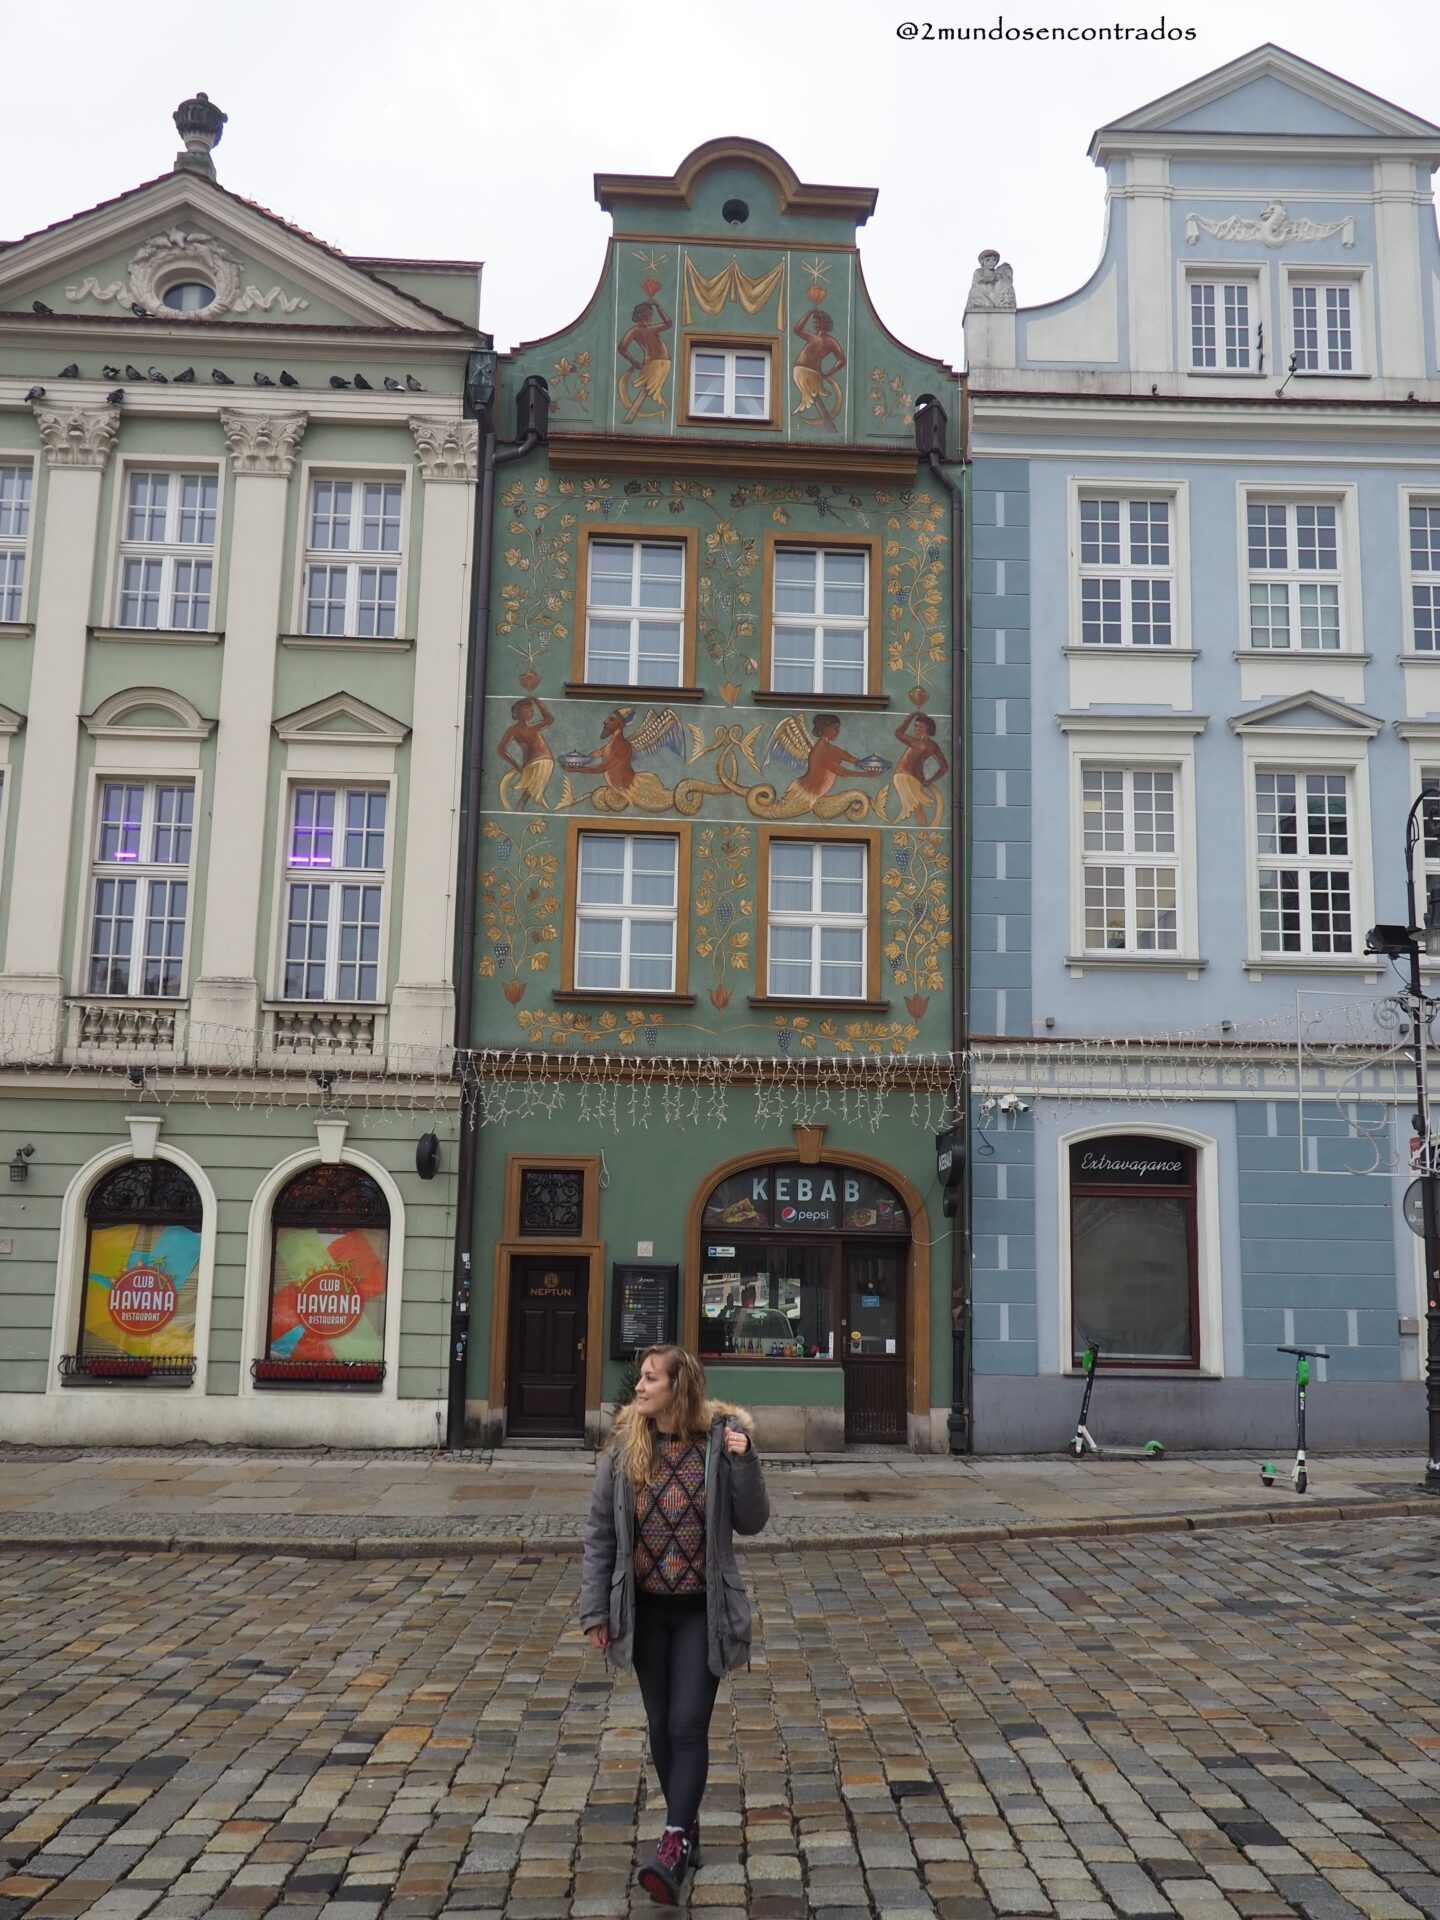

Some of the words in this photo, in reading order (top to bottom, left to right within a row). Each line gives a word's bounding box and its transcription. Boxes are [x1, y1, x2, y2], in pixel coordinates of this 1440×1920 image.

[938, 1150, 952, 1172] KEBAB
[1081, 1152, 1182, 1176] Extravagance
[752, 1178, 860, 1202] KEBAB
[798, 1209, 829, 1221] pepsi
[132, 1275, 154, 1288] CLUB
[319, 1279, 341, 1292] CLUB
[530, 1288, 572, 1296] NEPTUN
[109, 1289, 174, 1312] HAVANA
[296, 1293, 361, 1315] HAVANA
[121, 1312, 160, 1321] RESTAURANT
[308, 1315, 347, 1325] RESTAURANT
